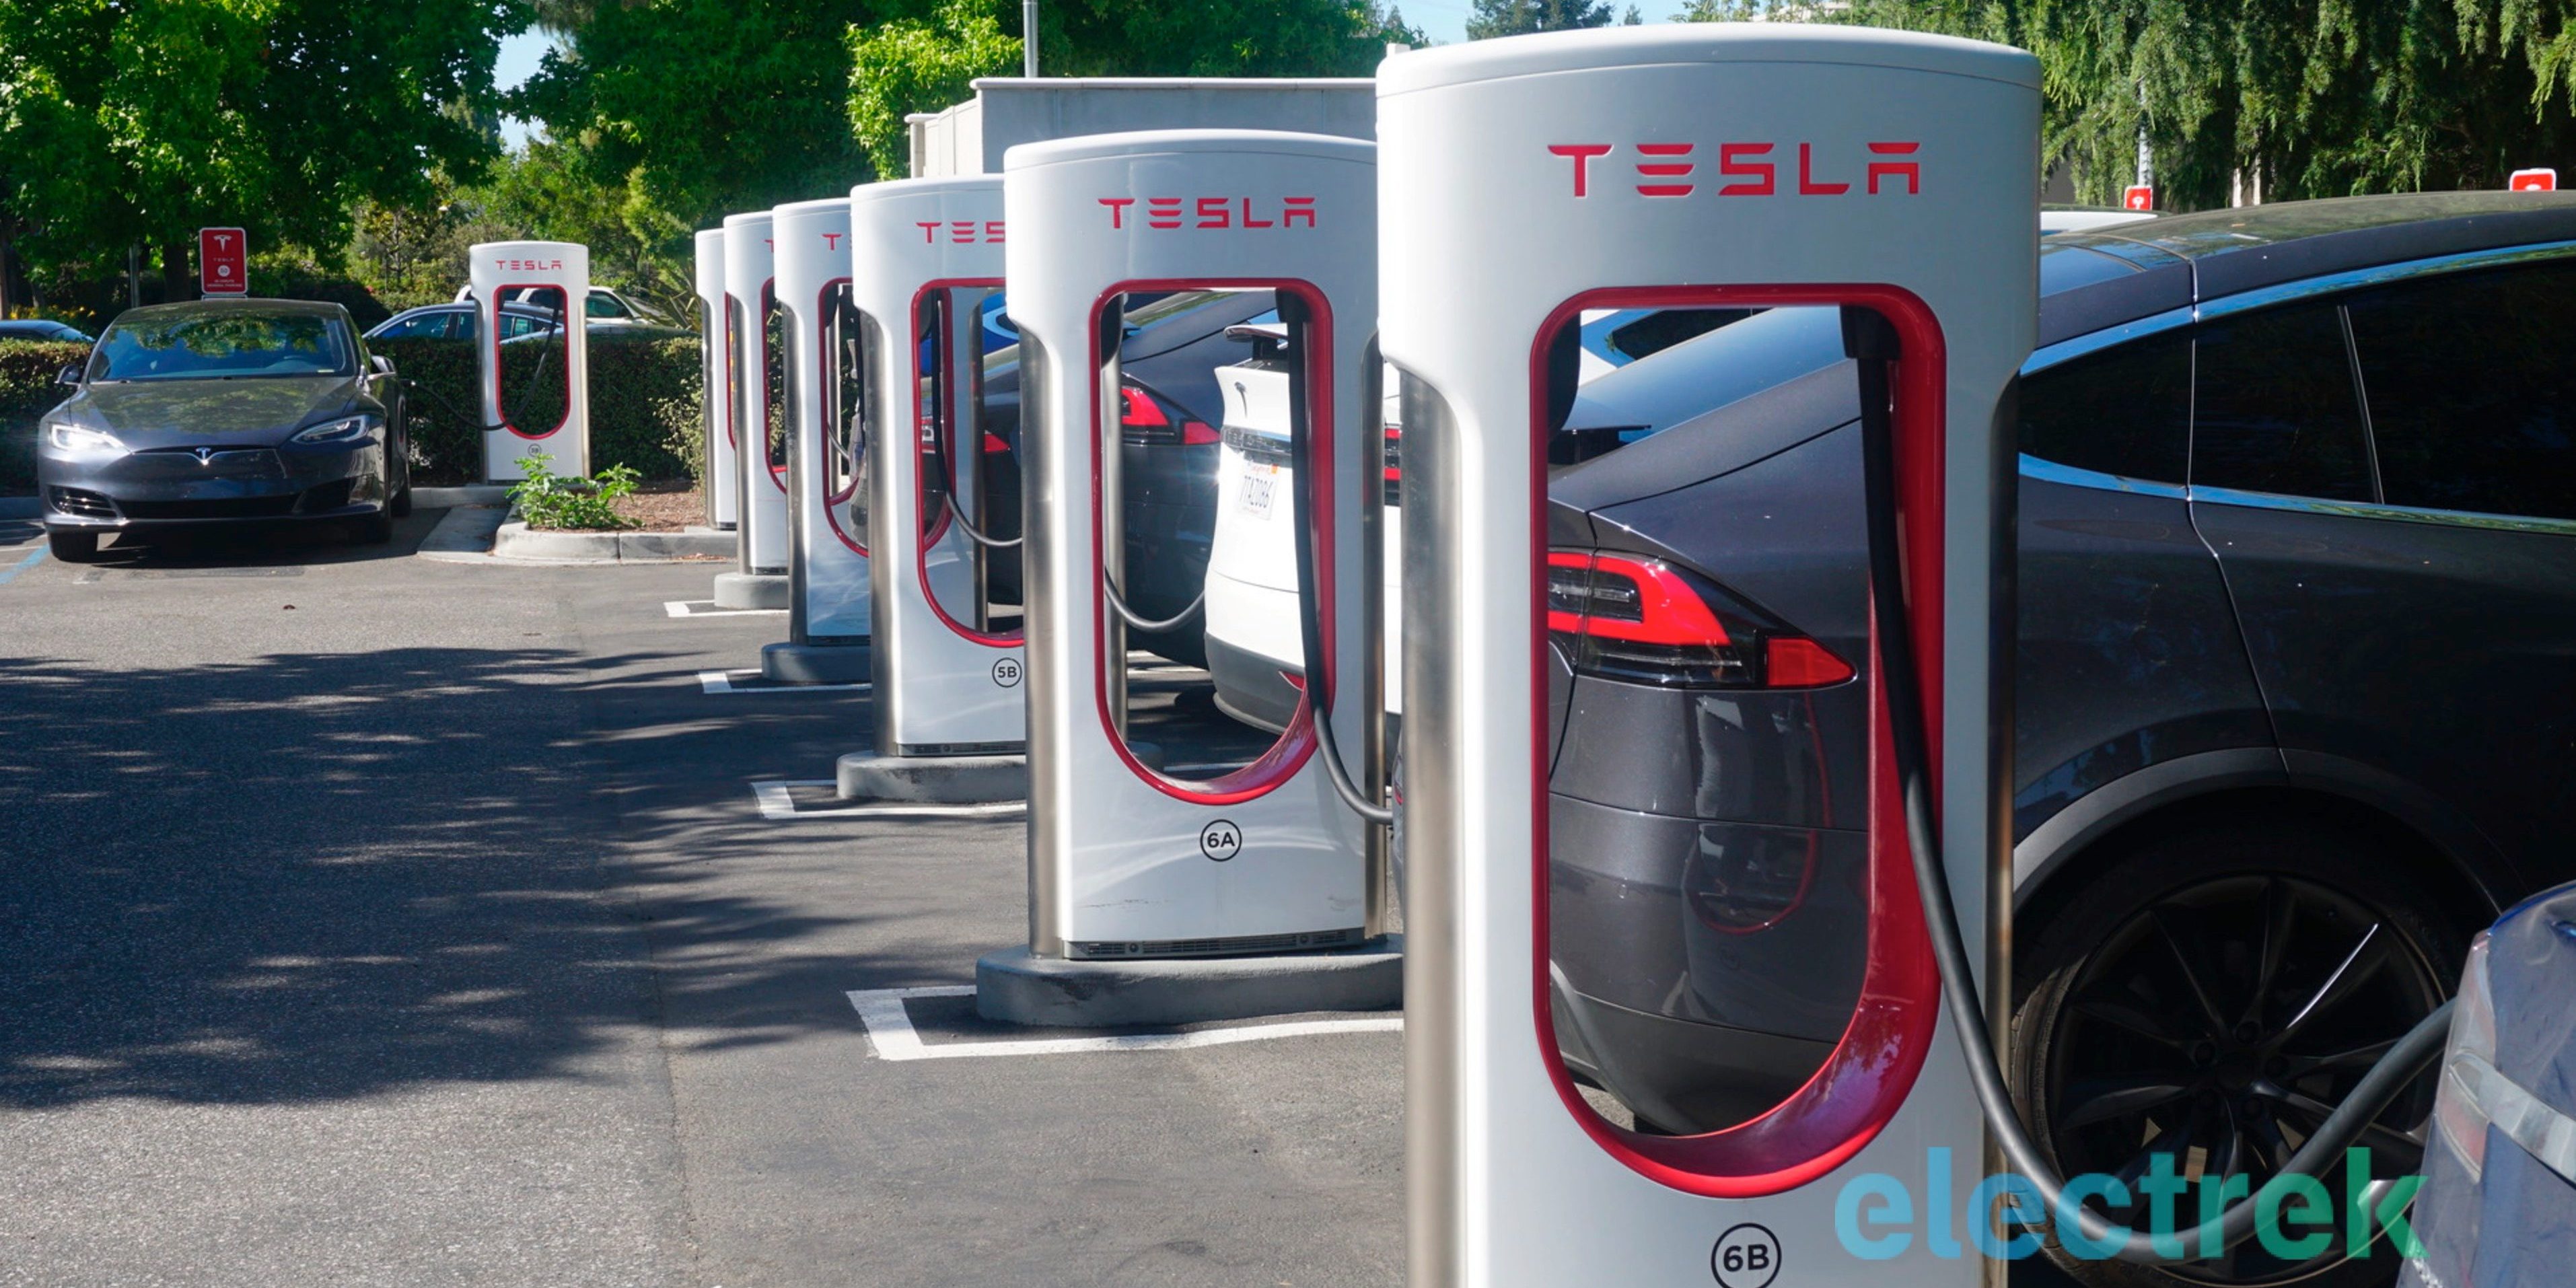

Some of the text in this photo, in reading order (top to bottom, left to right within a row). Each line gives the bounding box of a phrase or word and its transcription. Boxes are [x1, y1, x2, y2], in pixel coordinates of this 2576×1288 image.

[1548, 141, 1920, 198] TESLA
[1098, 197, 1316, 229] TESLA
[496, 260, 562, 271] TESLA
[998, 666, 1017, 678] 5B
[1207, 832, 1236, 848] 6A
[1723, 1244, 1770, 1272] 6B
